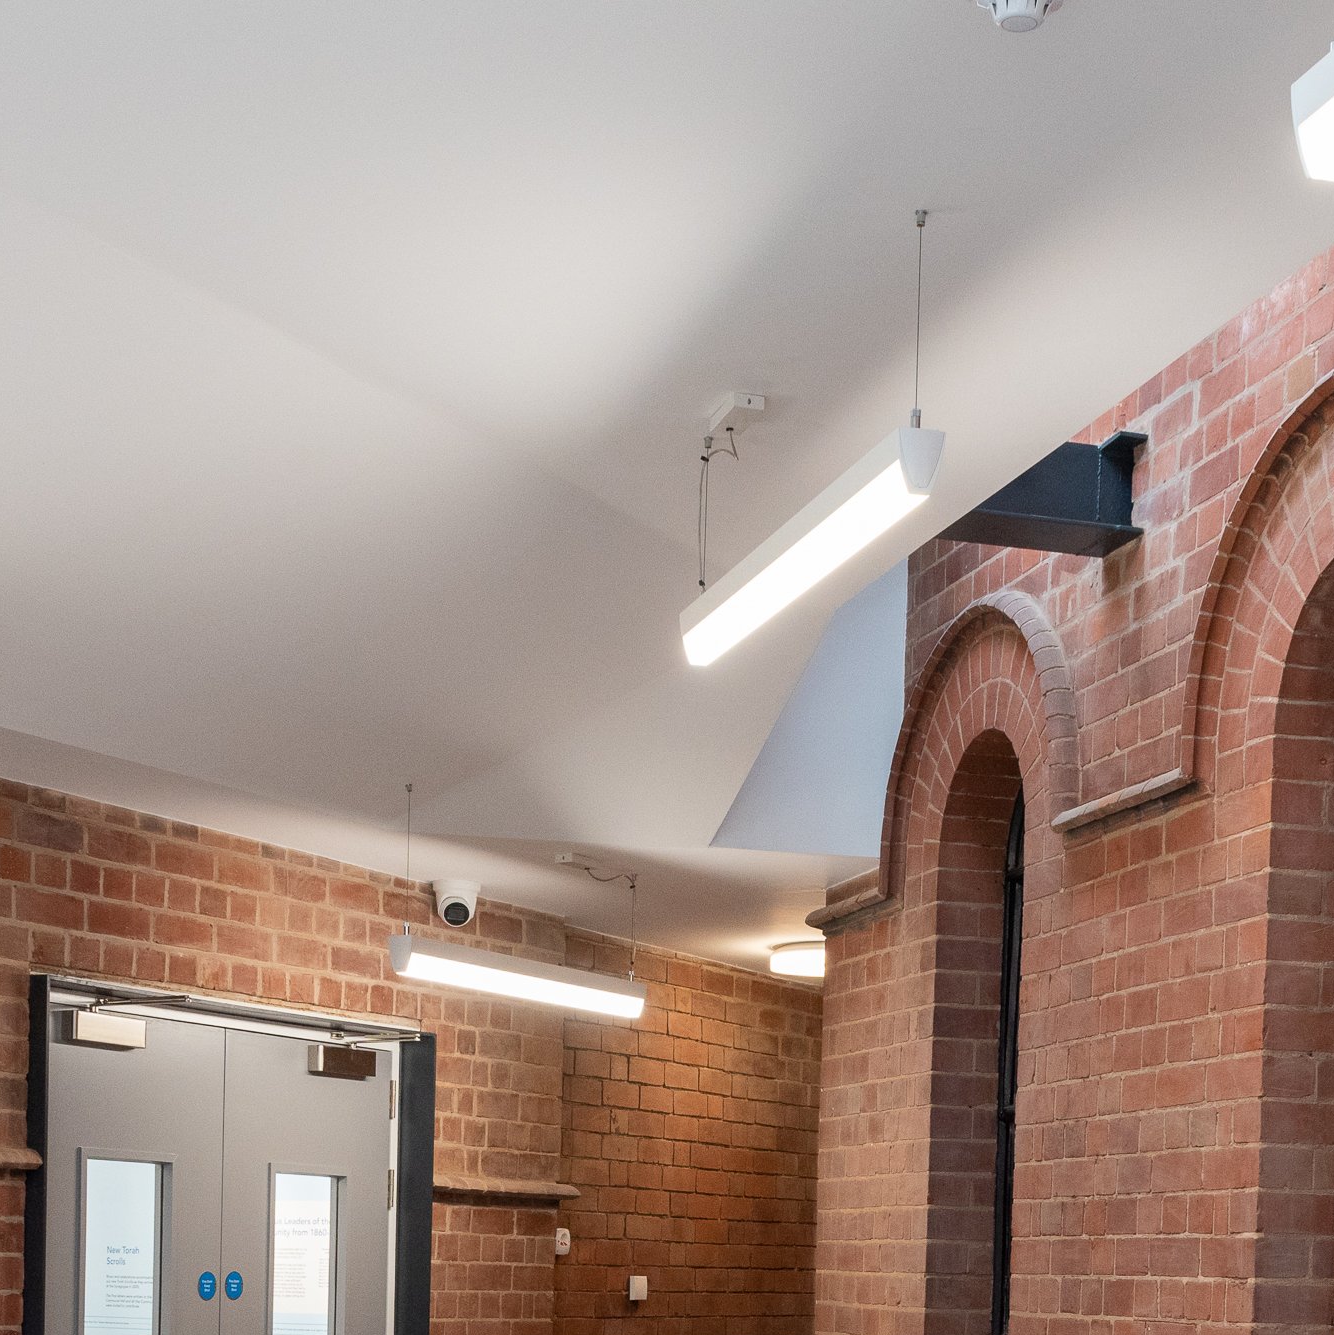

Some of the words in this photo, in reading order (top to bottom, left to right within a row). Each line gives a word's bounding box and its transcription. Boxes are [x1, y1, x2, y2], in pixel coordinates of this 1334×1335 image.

[284, 1217, 311, 1225] Leaders
[312, 1217, 320, 1225] of
[292, 1227, 308, 1236] from
[107, 1245, 121, 1254] New
[122, 1245, 139, 1255] Torah
[107, 1257, 126, 1266] Scrolls
